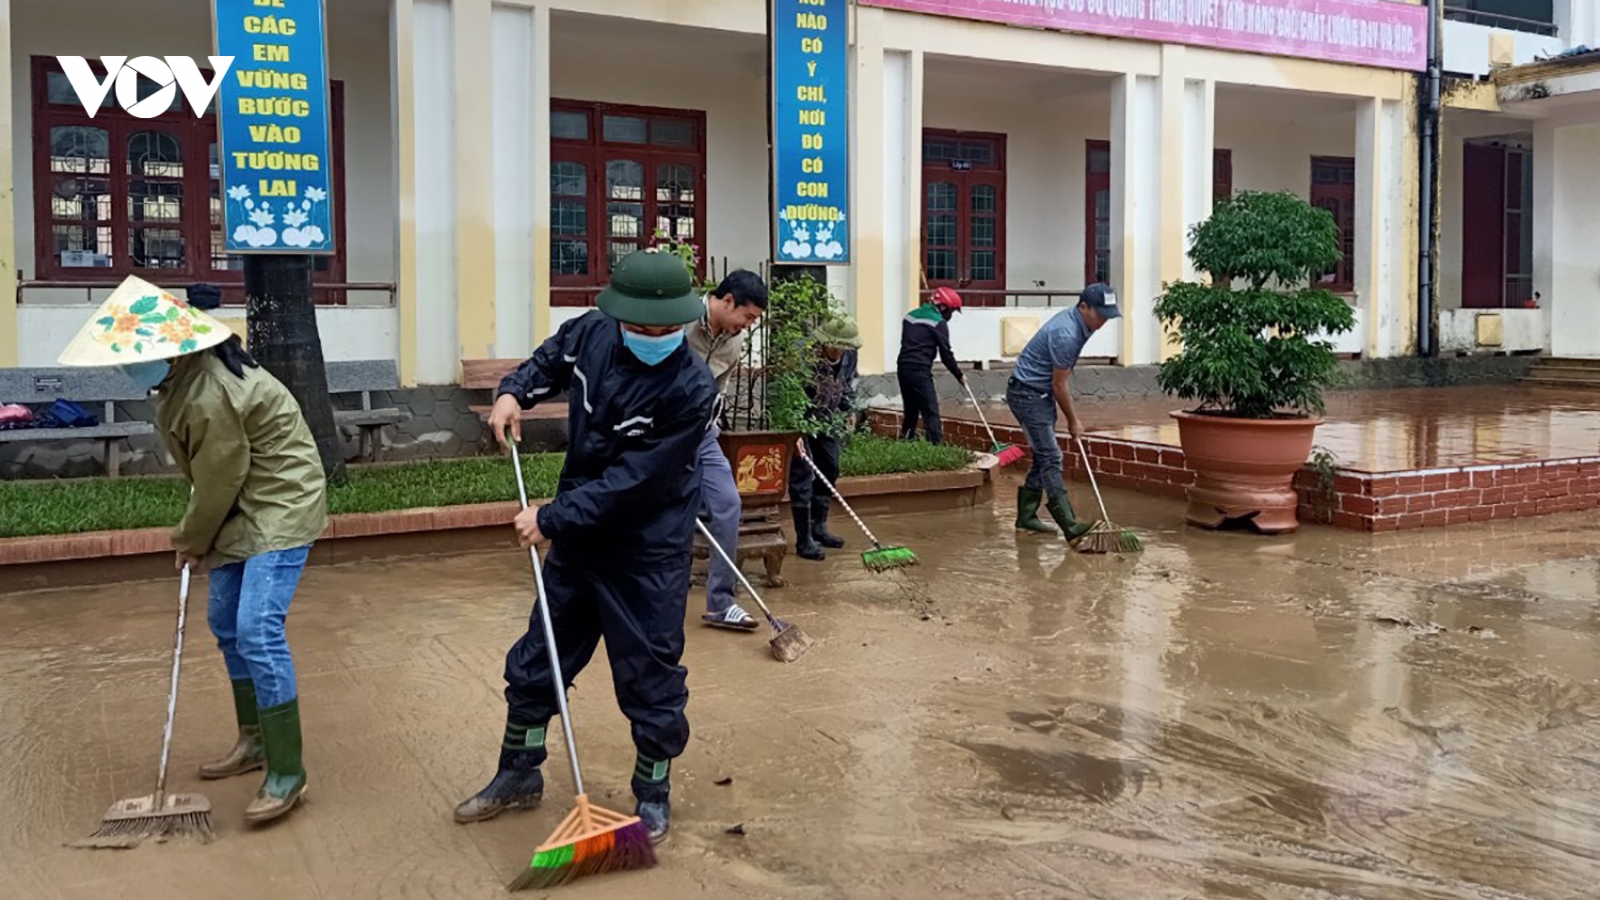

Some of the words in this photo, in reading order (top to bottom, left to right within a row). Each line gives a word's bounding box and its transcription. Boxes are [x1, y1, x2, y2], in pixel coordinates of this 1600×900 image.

[243, 15, 296, 35] CÁC
[796, 11, 827, 30] NÀO
[253, 44, 290, 62] EM
[801, 37, 823, 54] CÓ
[807, 61, 816, 77] Ý
[236, 68, 308, 90] VỮNG
[797, 85, 827, 103] CHÍ,
[238, 97, 310, 117] BƯỚC
[799, 109, 825, 125] NƠI
[249, 124, 301, 143] VÀO
[801, 133, 823, 149] ĐÓ
[232, 151, 319, 171] TƯƠNG
[801, 157, 823, 173] CÓ
[258, 179, 297, 197] LAI
[796, 181, 828, 197] CON
[785, 203, 838, 220] ĐƯỜNG
